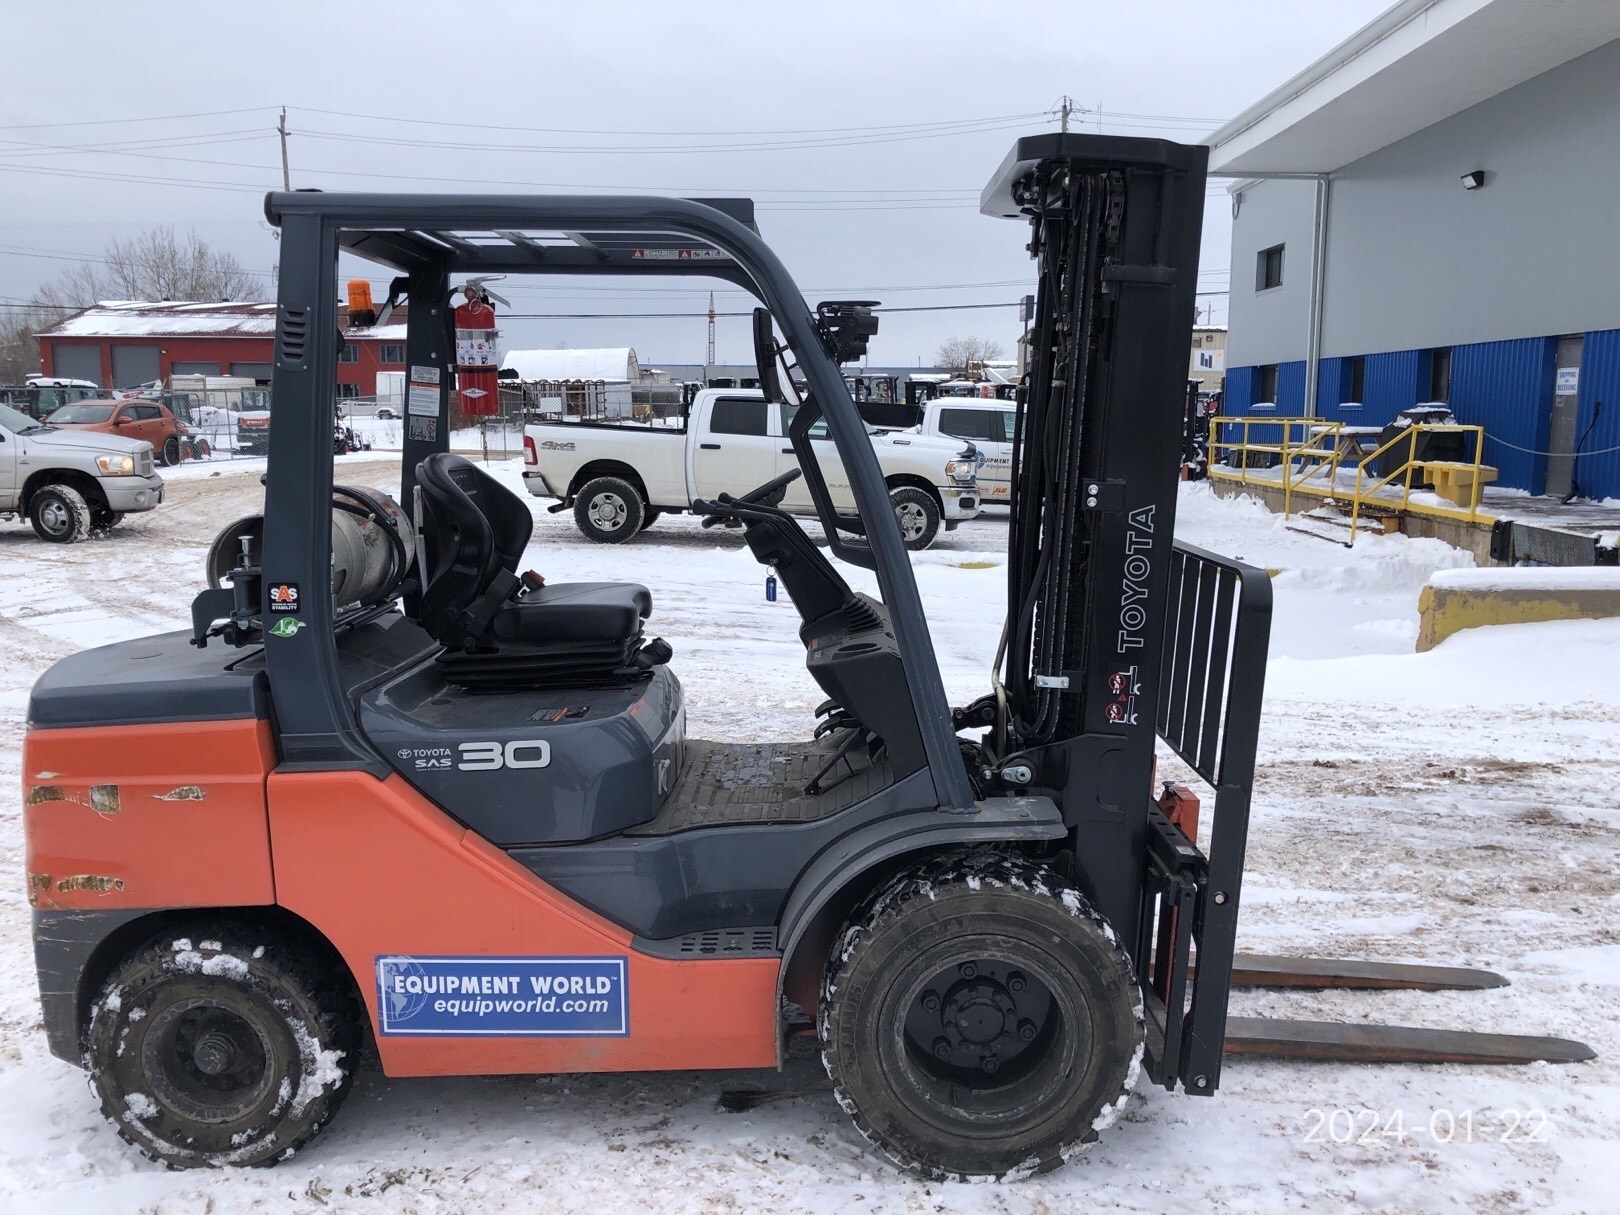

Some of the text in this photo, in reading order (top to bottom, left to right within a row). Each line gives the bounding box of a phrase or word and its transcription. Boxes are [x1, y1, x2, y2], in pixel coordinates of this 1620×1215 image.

[1117, 504, 1156, 653] TOYOTA
[270, 585, 298, 602] SAS
[413, 748, 452, 757] TOYOTA
[458, 739, 551, 771] 30
[415, 758, 452, 768] SAS
[394, 975, 520, 995] EQUIPMENT
[529, 976, 612, 995] WORLD
[434, 996, 609, 1016] equipworld.com
